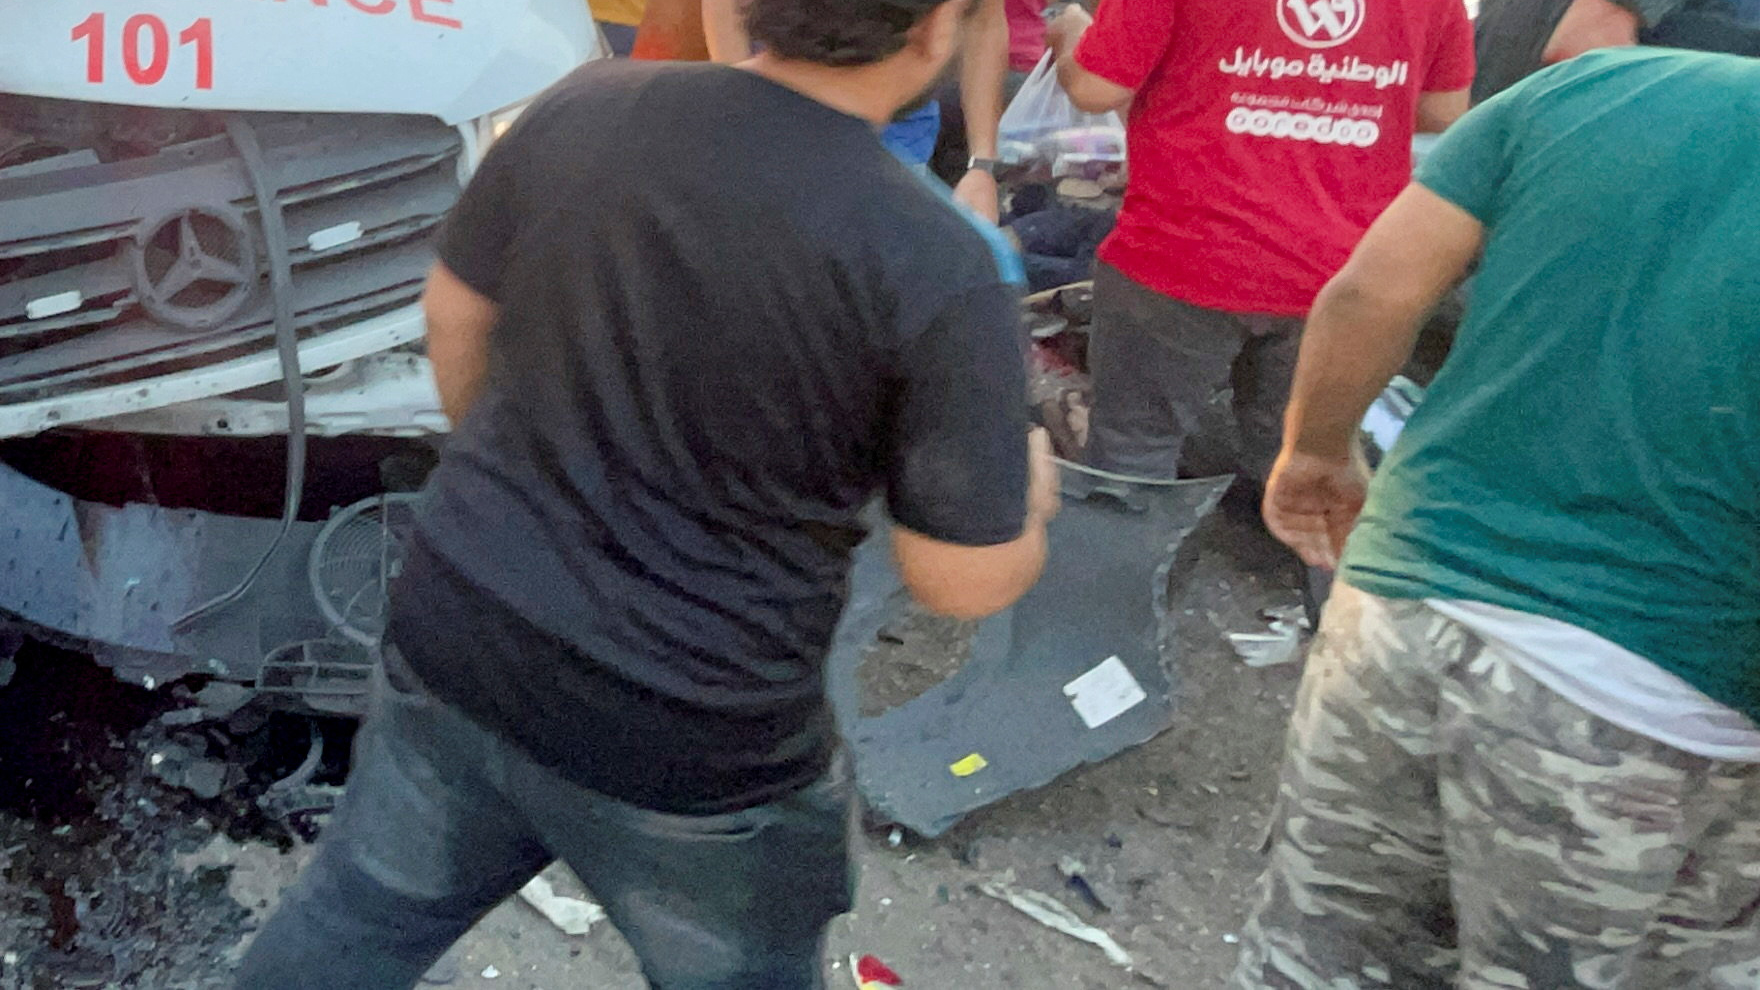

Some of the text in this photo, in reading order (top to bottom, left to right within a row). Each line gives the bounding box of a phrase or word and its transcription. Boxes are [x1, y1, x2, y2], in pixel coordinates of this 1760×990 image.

[71, 12, 216, 90] 101
[1219, 45, 1409, 90] الوطنية موبايل
